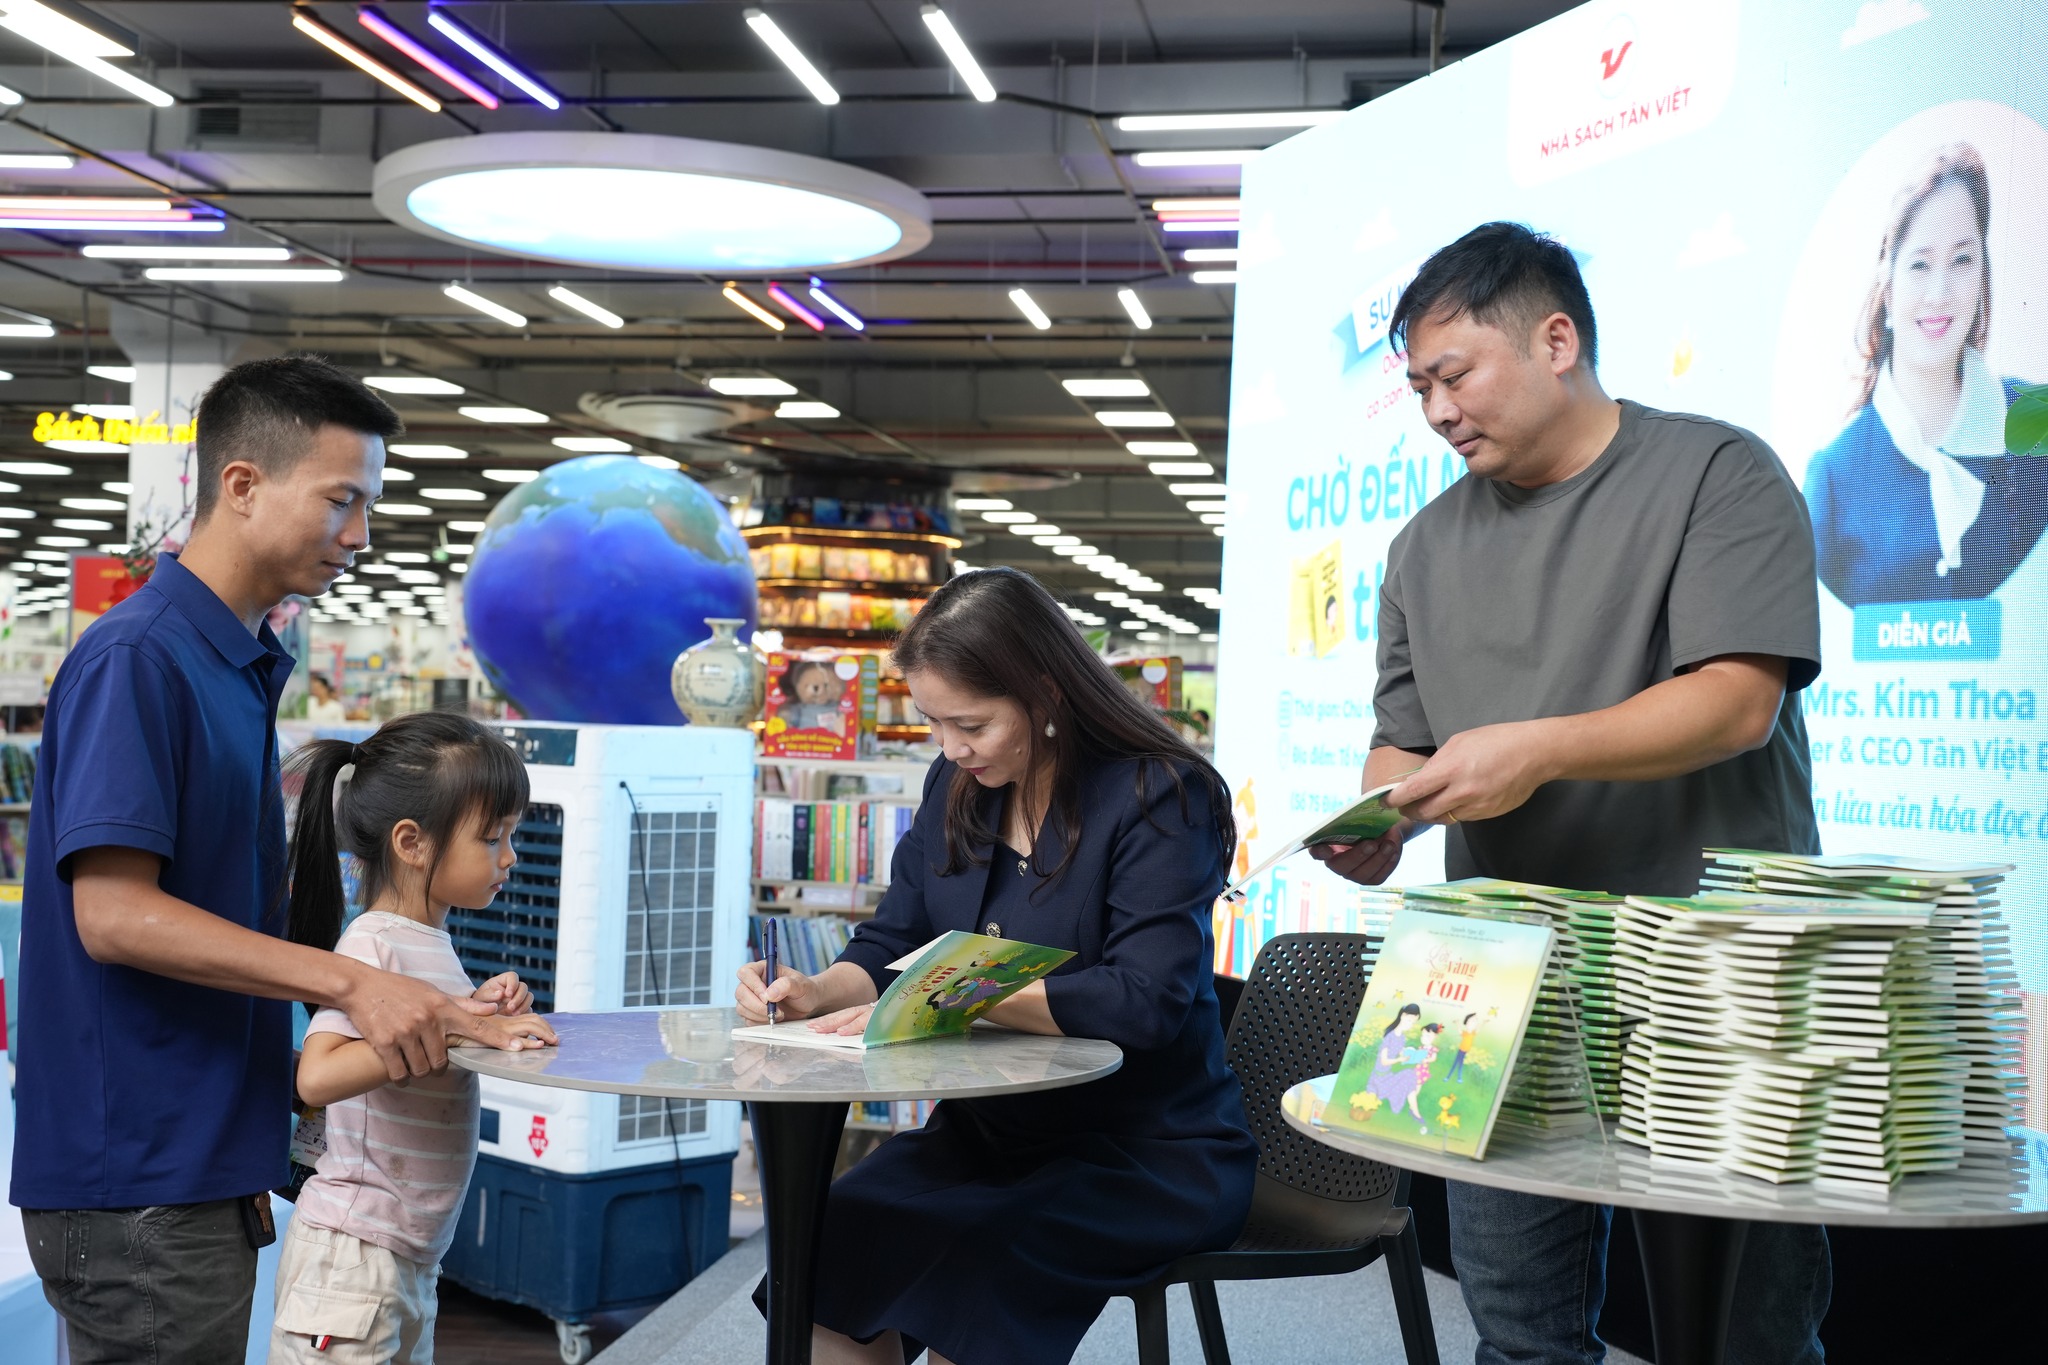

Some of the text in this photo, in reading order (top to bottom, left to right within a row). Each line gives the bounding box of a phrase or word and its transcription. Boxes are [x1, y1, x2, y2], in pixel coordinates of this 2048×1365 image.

[32, 411, 103, 442] Sách
[1287, 454, 1351, 532] CHỜ
[1360, 432, 1428, 523] ĐẾN
[1804, 677, 2036, 720] Mrs. Kim Thoa
[1839, 736, 1853, 763] &
[1861, 736, 1912, 766] CEO
[1919, 738, 1966, 768] Tân
[1973, 737, 2029, 780] Việt
[1879, 795, 1921, 829] văn
[1930, 795, 1976, 833] hóa
[1983, 799, 2031, 844] đọc
